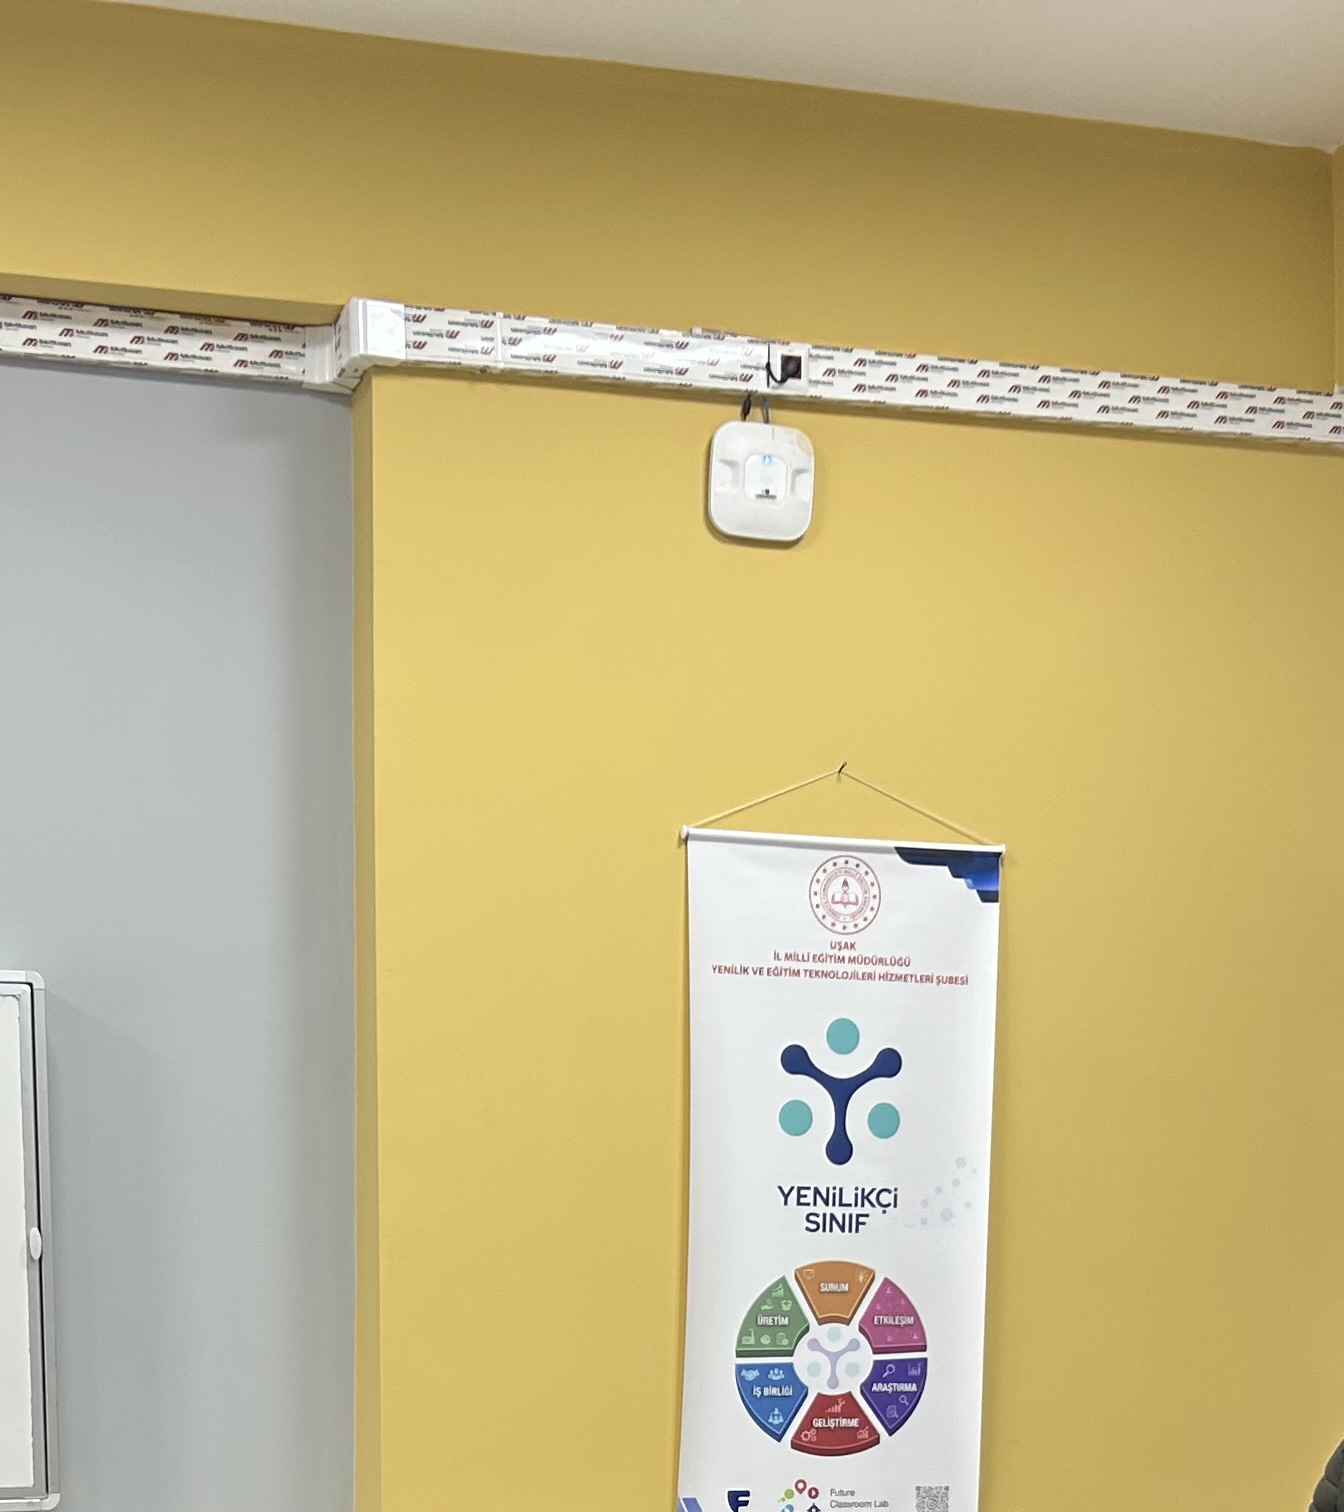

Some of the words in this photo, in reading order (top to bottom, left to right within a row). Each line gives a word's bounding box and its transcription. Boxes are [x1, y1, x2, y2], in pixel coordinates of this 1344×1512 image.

[830, 940, 856, 951] UŞAK
[773, 950, 782, 961] İL
[812, 953, 845, 964] EĞİTİM
[848, 954, 911, 967] MÜDÜRLÜĞÜ
[712, 964, 749, 975] YENİLİK
[752, 967, 764, 976] VE
[767, 966, 800, 977] EĞİTİM
[803, 969, 876, 980] TEKNOLOJİLERİ
[878, 971, 933, 983] HİZMETLERİ
[936, 974, 968, 986] ŞUBESİ
[805, 1212, 869, 1233] SINIF
[757, 1315, 788, 1326] ÜRETİM
[830, 1488, 855, 1497] Future
[830, 1500, 871, 1508] Classroom
[874, 1500, 889, 1508] Lab
